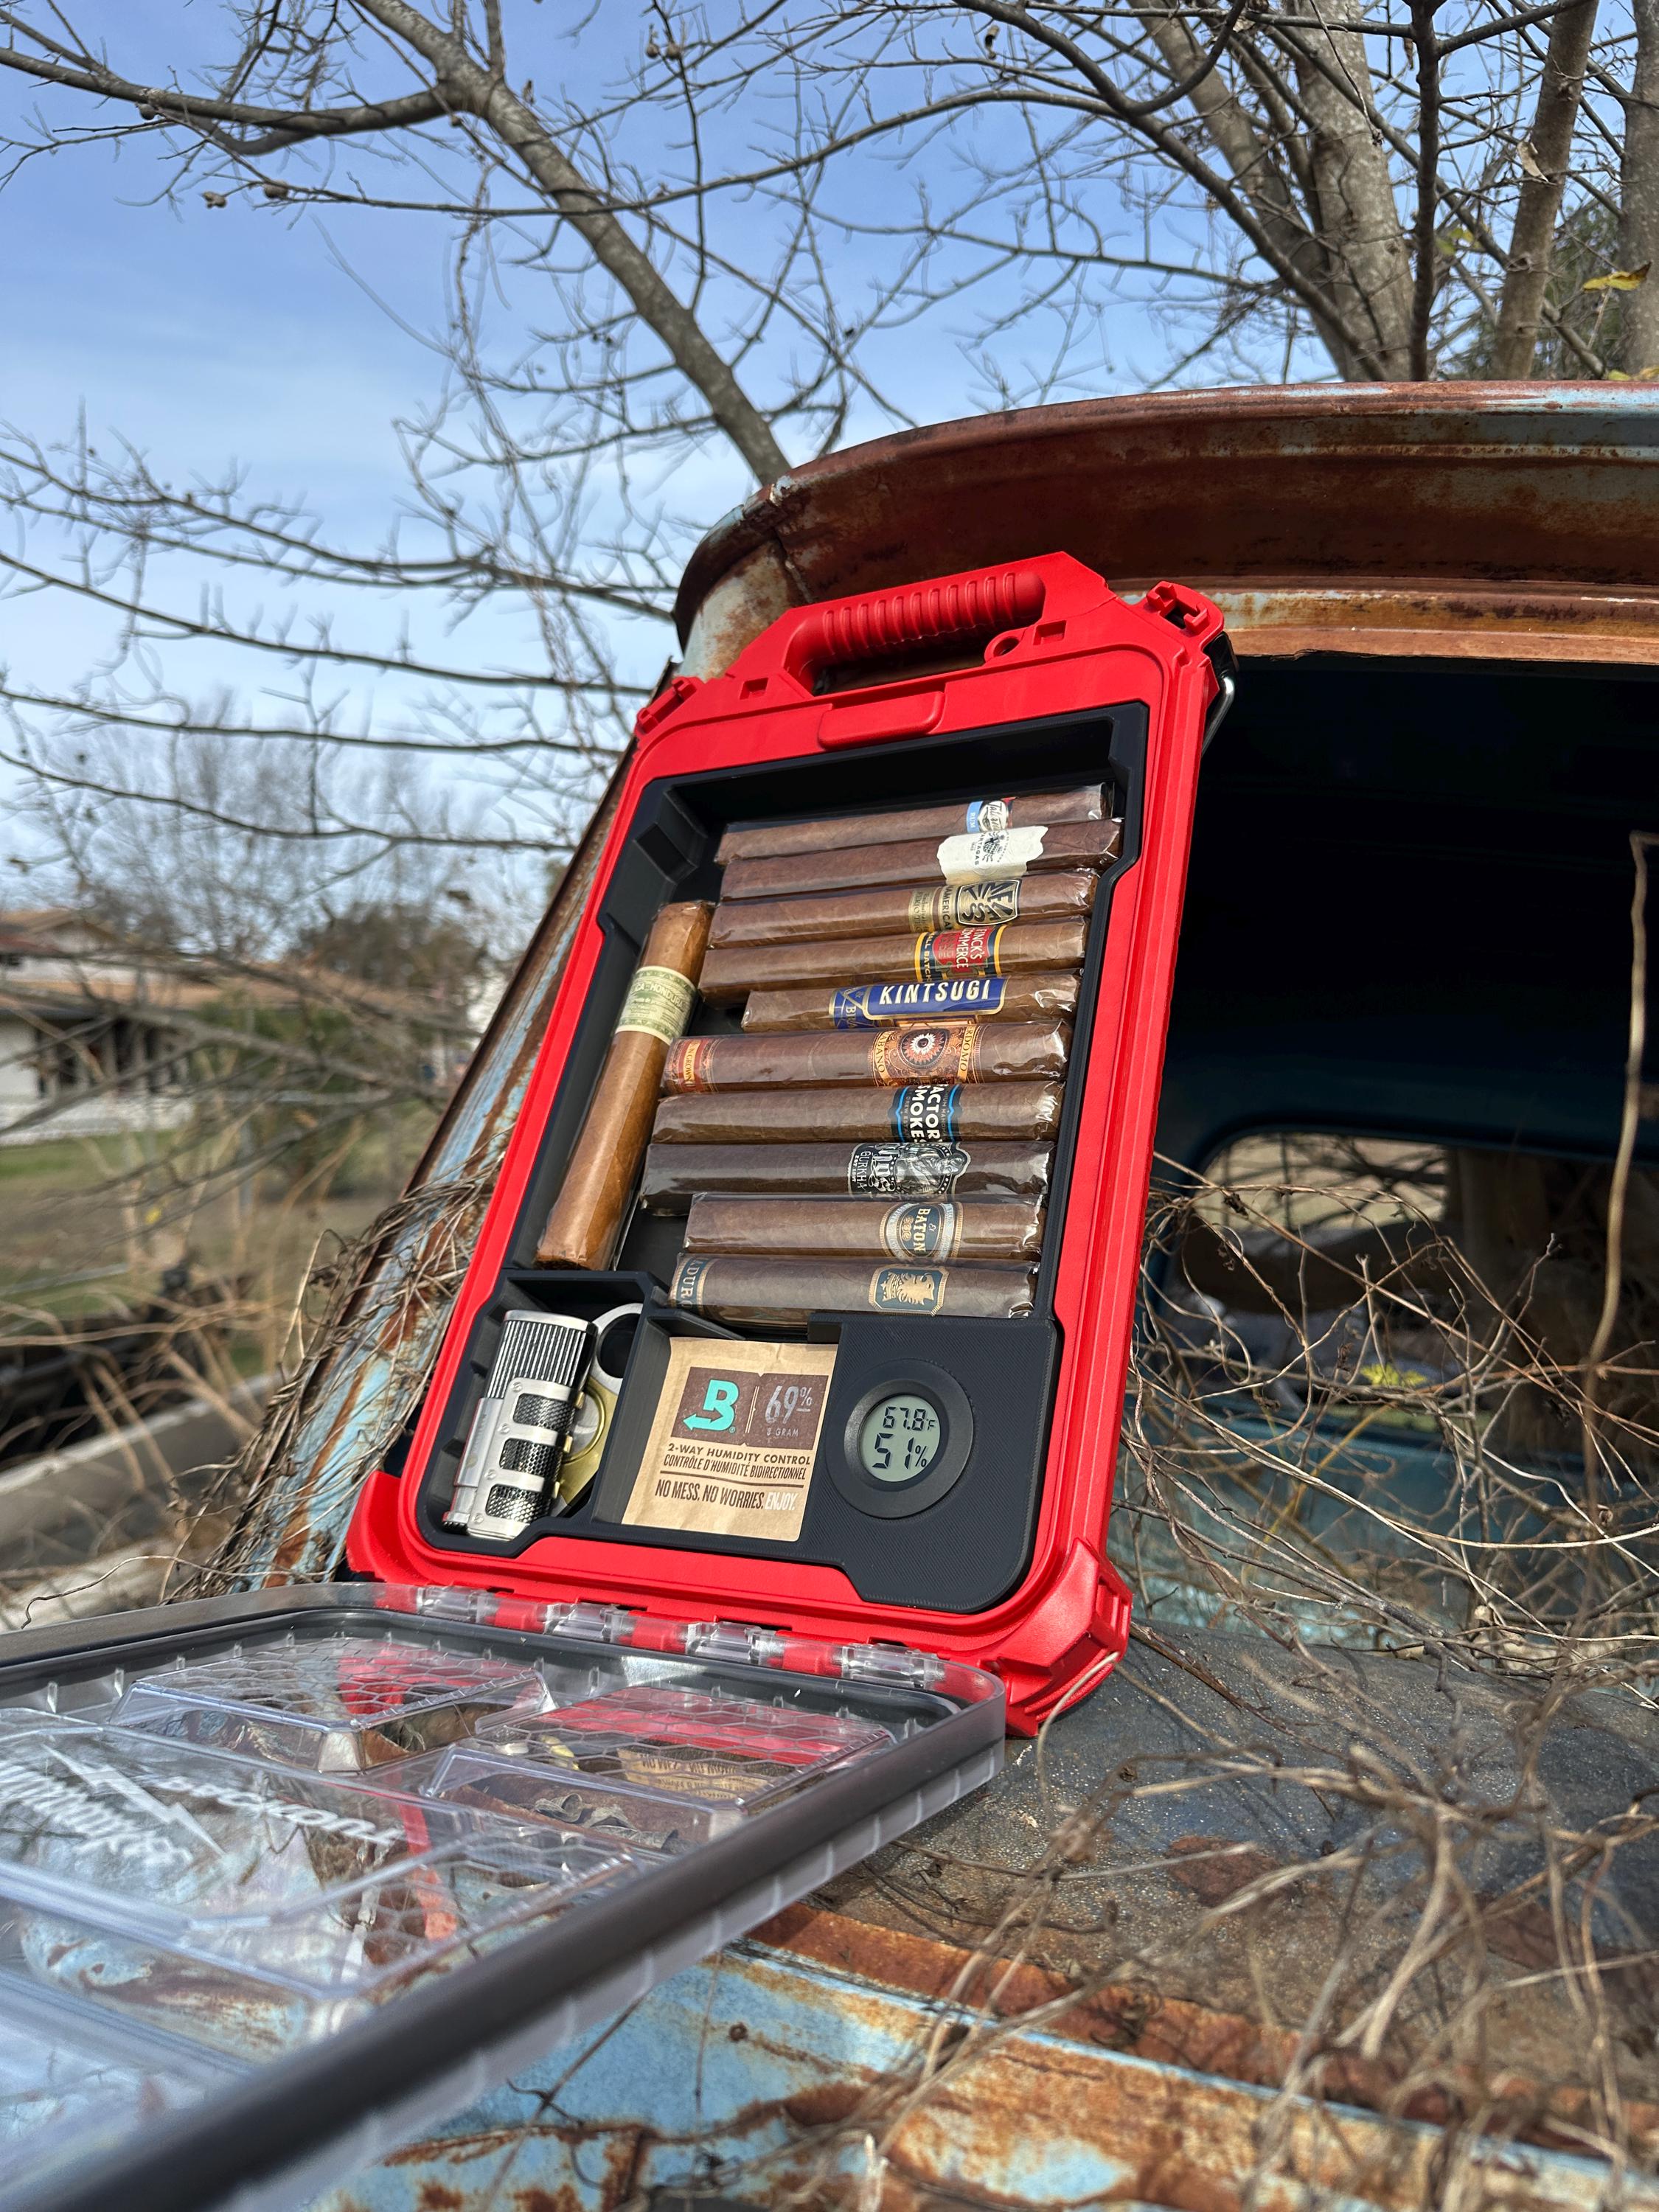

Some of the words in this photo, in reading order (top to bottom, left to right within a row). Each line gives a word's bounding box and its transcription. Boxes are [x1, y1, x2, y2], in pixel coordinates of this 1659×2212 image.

[956, 928, 975, 968] COMMERCE
[970, 928, 987, 959] FINCK'S
[923, 950, 932, 982] BATCH
[650, 983, 685, 1012] HONDURAS
[878, 979, 991, 1005] KINTSUGI
[685, 1054, 693, 1081] GROWN
[909, 1085, 928, 1143] SMOKES
[856, 1151, 872, 1191] GURKHA
[913, 1208, 931, 1252] BATON
[765, 1385, 813, 1424] 69%
[776, 1427, 799, 1437] GRAM
[664, 1453, 703, 1470] CONTRÔLE
[703, 1459, 751, 1477] D'HUMIDITÉ
[749, 1465, 807, 1480] BIDIRECTIONNEL
[667, 1442, 704, 1455] 2-WAY
[706, 1448, 760, 1462] HUMIDITY
[763, 1454, 811, 1465] CONTROL
[872, 1433, 928, 1470] 51%
[655, 1479, 672, 1498] NO
[671, 1481, 700, 1501] MESS.
[702, 1484, 719, 1503] NO
[719, 1489, 765, 1509] WORRIES.
[765, 1492, 799, 1511] ENJOY.
